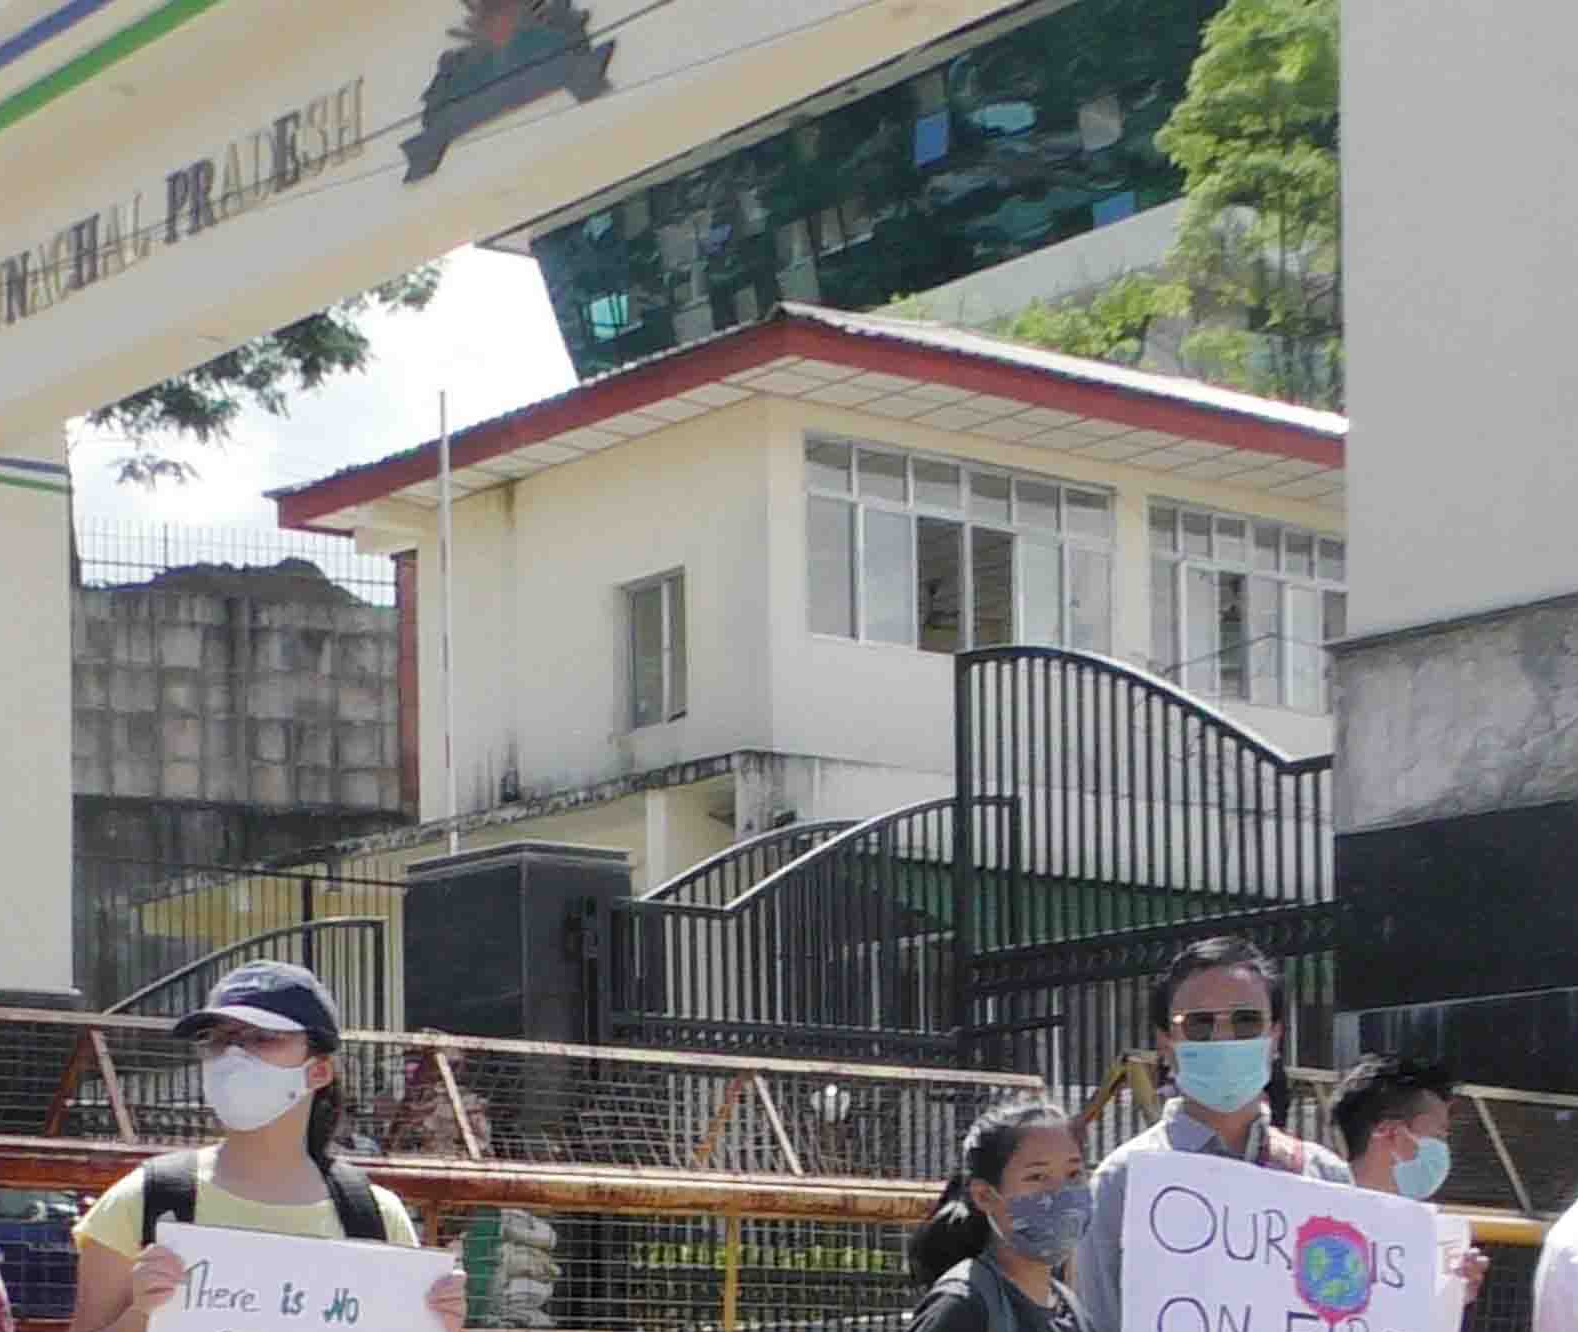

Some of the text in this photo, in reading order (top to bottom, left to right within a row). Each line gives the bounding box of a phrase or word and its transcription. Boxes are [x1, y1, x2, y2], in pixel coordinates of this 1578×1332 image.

[165, 76, 365, 244] PRADESH
[1150, 1186, 1405, 1289] OUR IS
